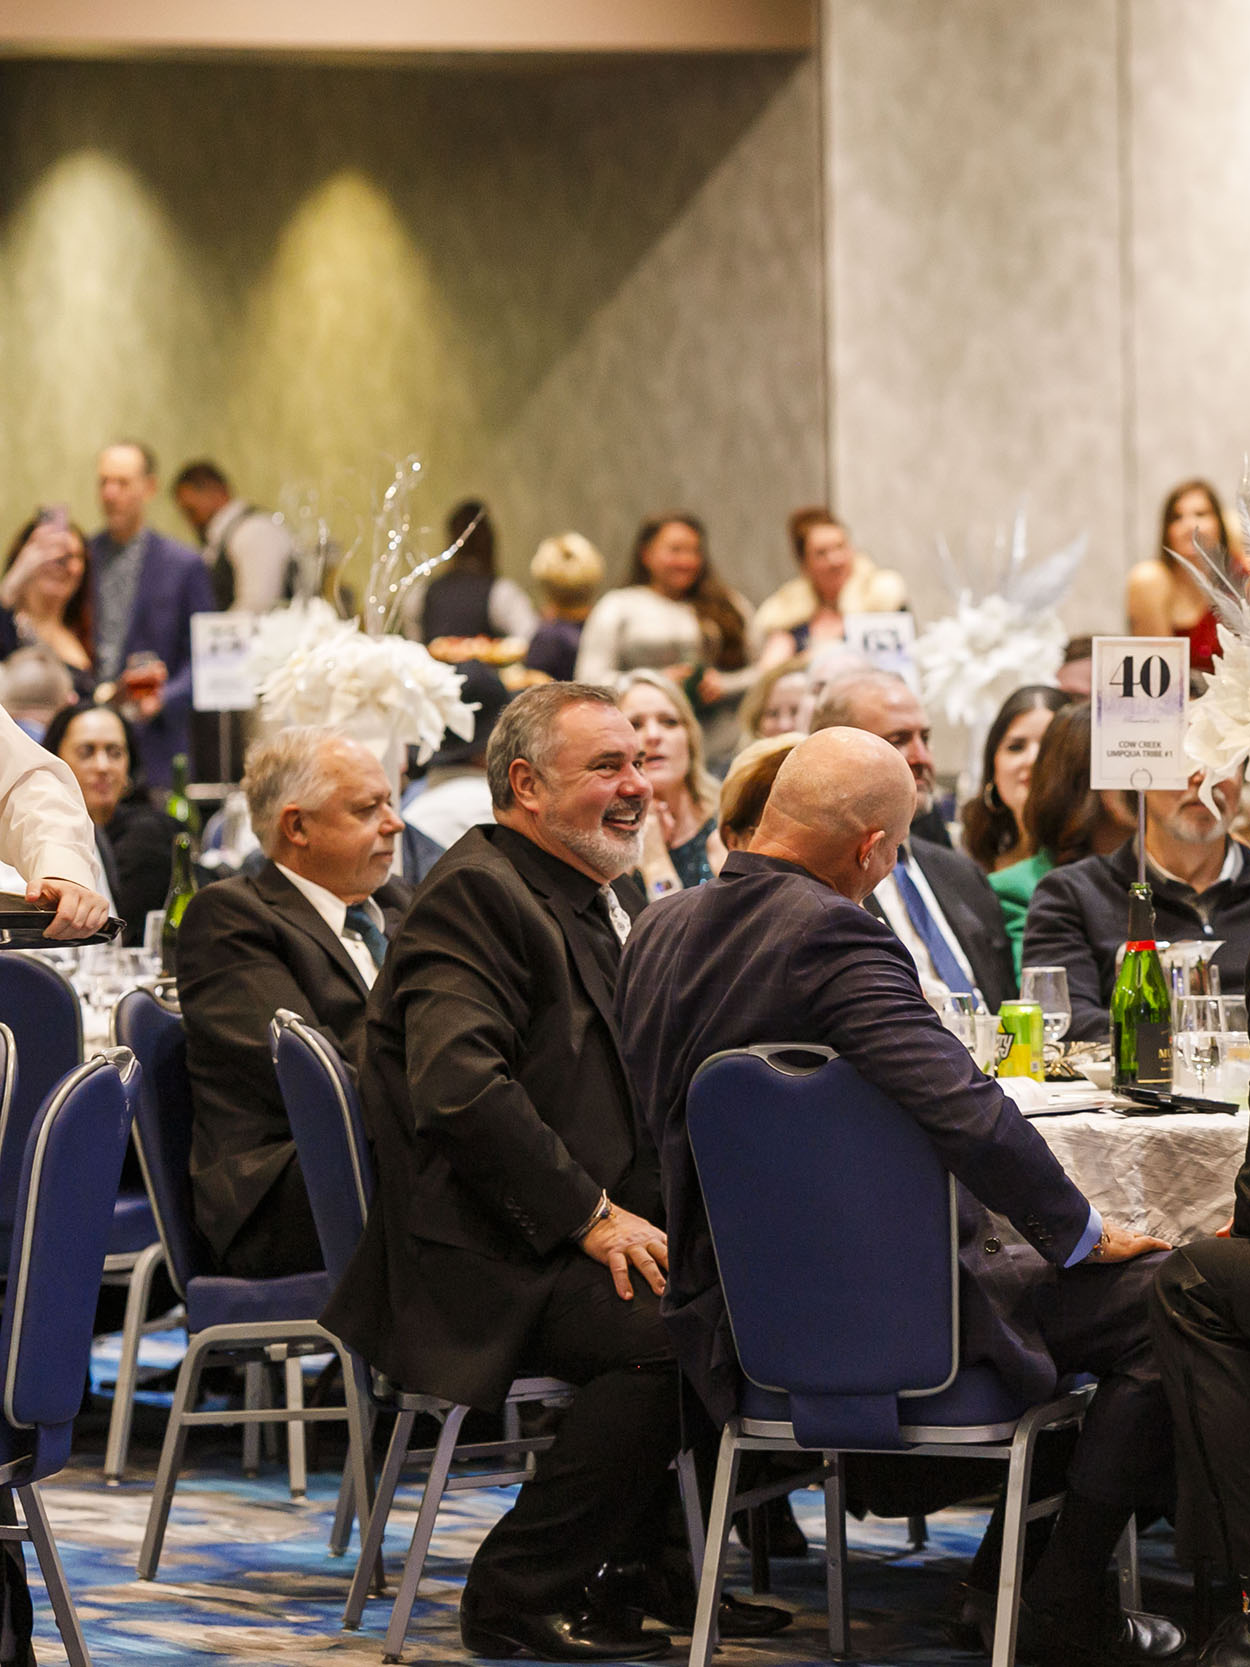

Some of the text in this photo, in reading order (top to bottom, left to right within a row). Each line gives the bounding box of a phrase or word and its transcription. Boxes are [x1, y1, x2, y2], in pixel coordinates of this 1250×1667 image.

[1109, 655, 1171, 698] 40
[1118, 740, 1162, 749] COW CREEK
[1106, 750, 1174, 758] UMPQUA TRIBE #1
